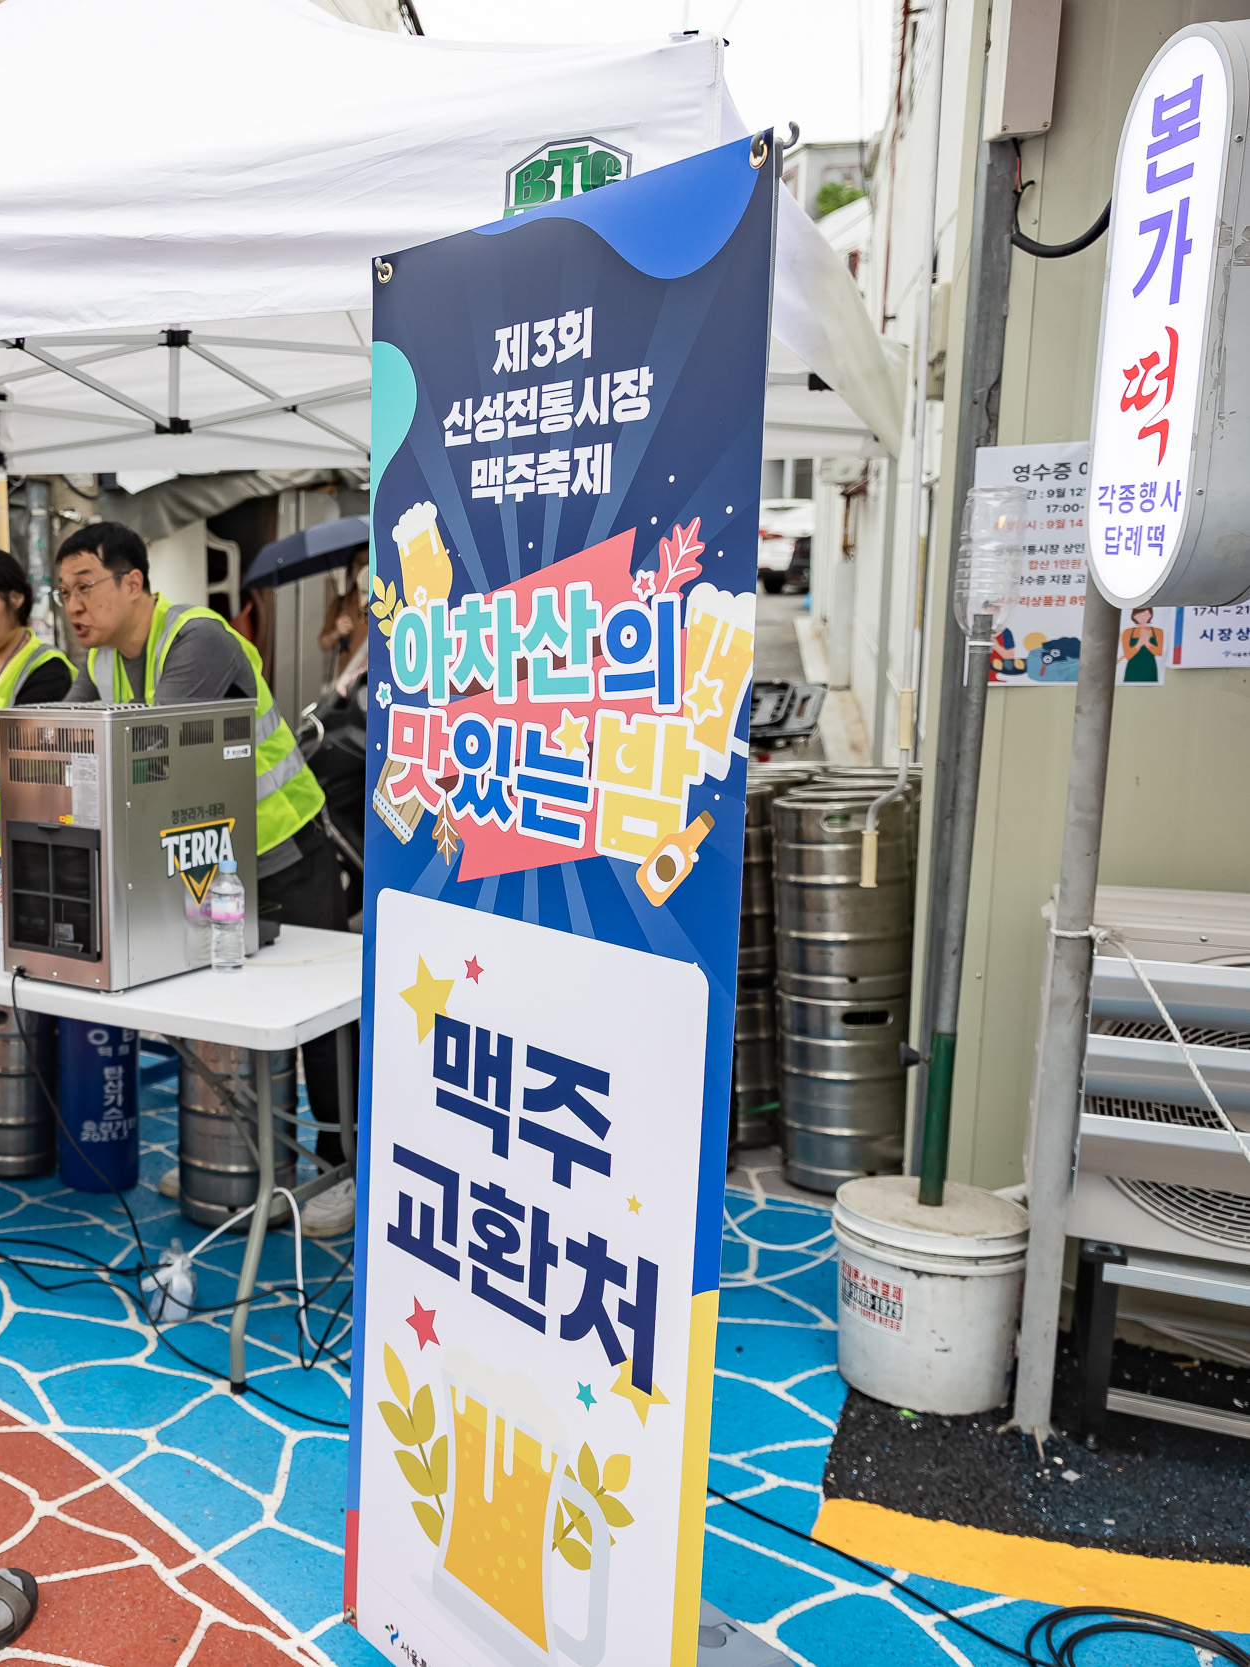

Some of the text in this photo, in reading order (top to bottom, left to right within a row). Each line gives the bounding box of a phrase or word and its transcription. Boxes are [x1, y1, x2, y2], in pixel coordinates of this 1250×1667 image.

[1119, 73, 1204, 467] 본가 떡
[492, 306, 593, 375] 제3회
[442, 365, 654, 447] 신성전통시장
[471, 442, 613, 504] 맥주축제
[1013, 462, 1072, 482] 영수증
[1070, 486, 1086, 497] 12
[1098, 479, 1181, 514] 각종행사
[1104, 524, 1165, 556] 답례떡
[391, 583, 678, 709] 아차산의
[389, 708, 701, 860] 맛있는 밤
[161, 827, 236, 878] TERRA
[433, 1013, 612, 1190] 맥주
[387, 1143, 659, 1396] 교환처
